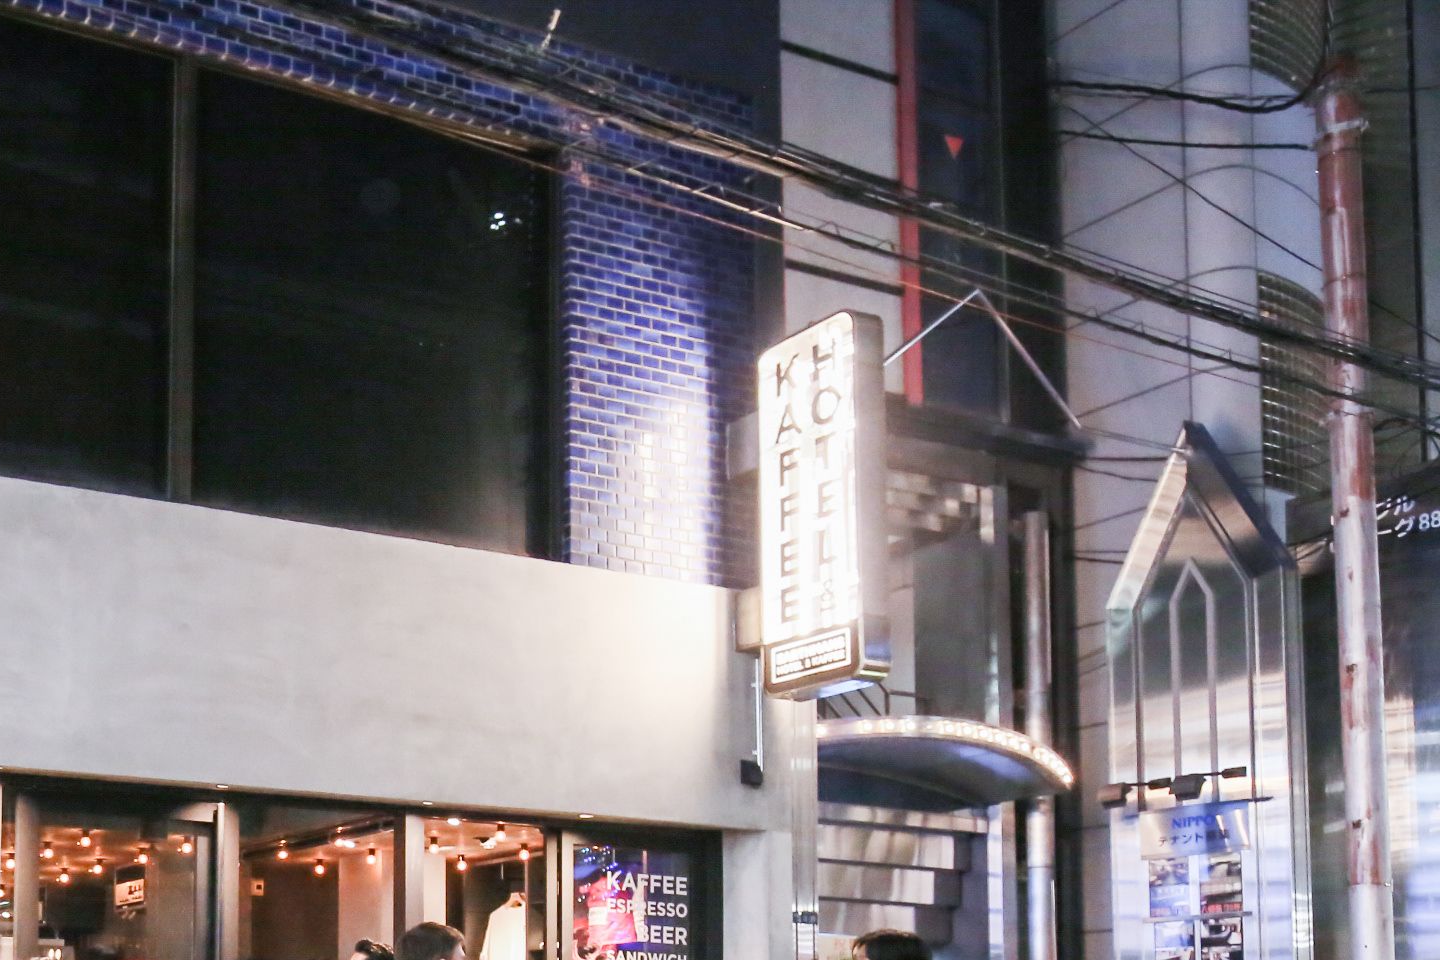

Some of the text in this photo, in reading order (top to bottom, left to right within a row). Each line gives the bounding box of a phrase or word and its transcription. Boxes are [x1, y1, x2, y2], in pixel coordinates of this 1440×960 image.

[811, 337, 841, 565] HOTEL
[775, 351, 802, 626] KAFFEE
[1172, 814, 1220, 829] NIPPO
[606, 870, 688, 896] KAFFEE
[607, 898, 688, 918] ESPRESSO
[636, 923, 688, 946] BEER
